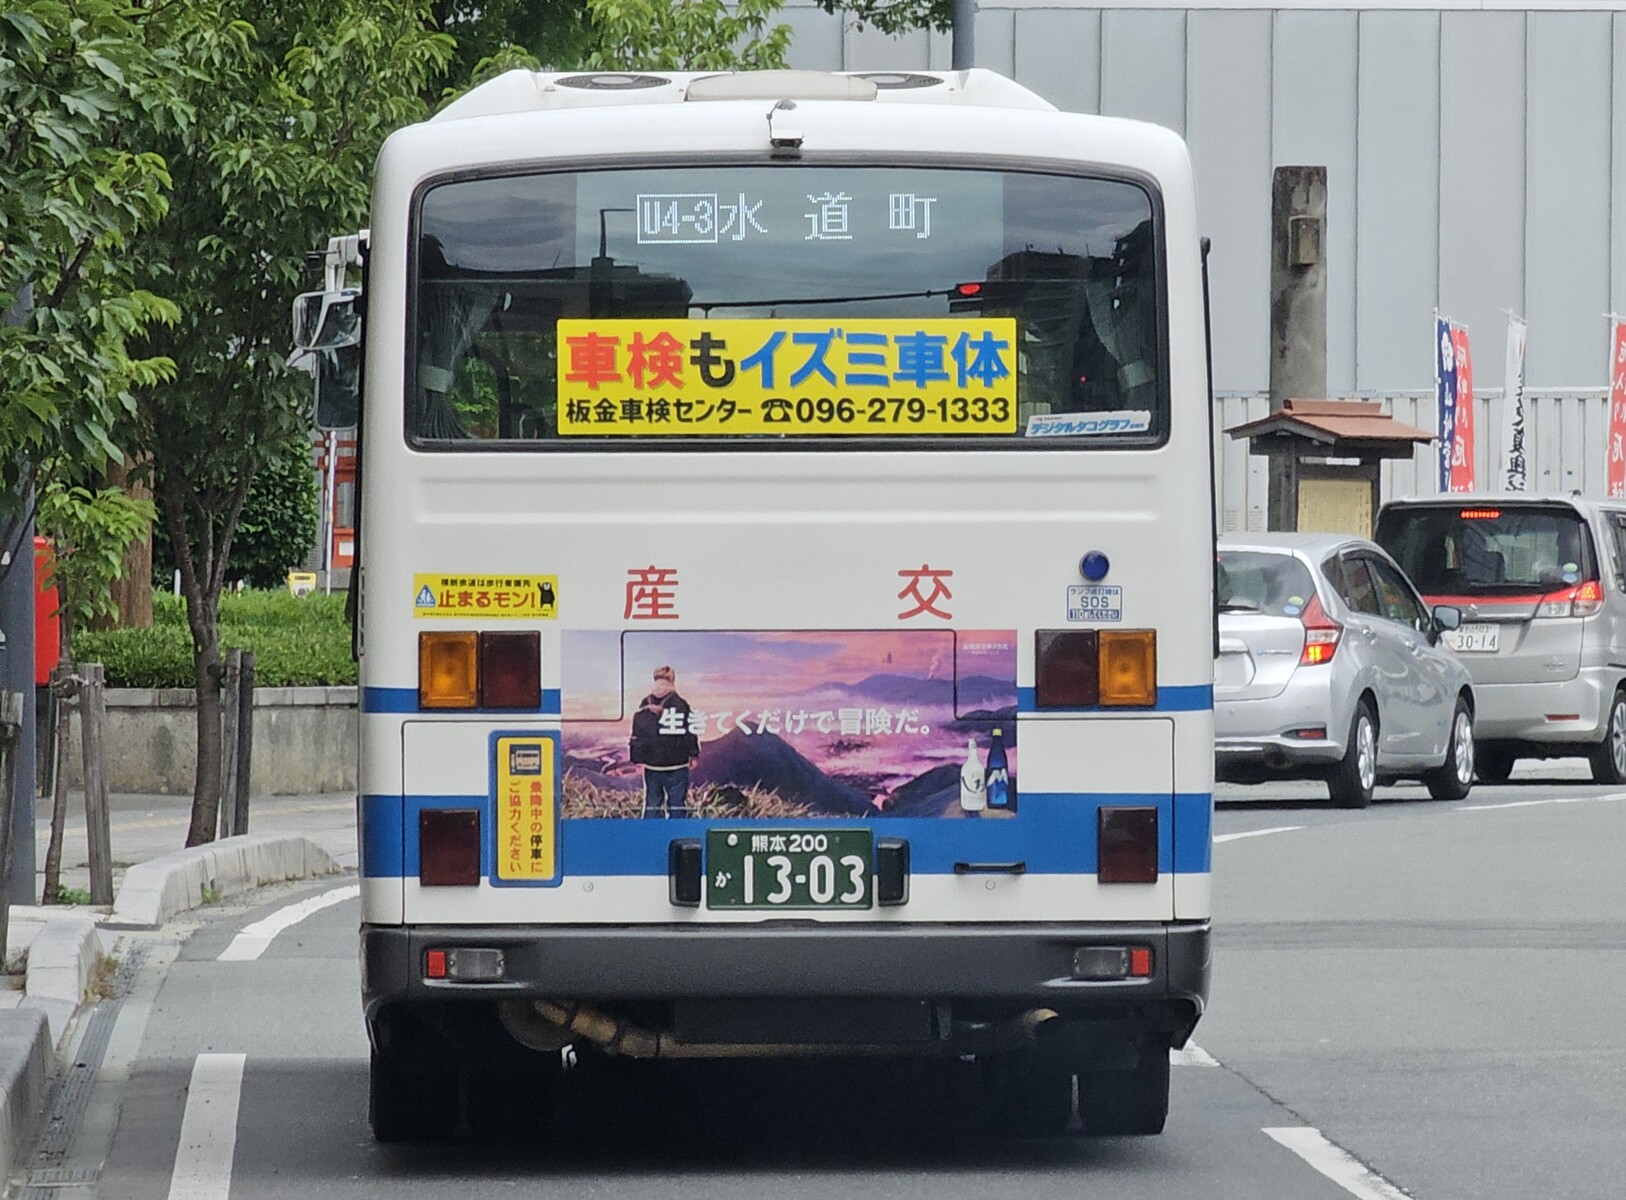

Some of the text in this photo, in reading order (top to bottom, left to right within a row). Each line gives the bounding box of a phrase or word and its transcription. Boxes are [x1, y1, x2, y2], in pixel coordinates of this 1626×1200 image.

[565, 327, 1011, 390] 車検もイズミ車体
[565, 397, 1010, 424] 板金車検センター 096-279-1333
[623, 563, 953, 620] 産 交
[1080, 596, 1109, 608] SOS
[1457, 634, 1496, 649] 30-14
[658, 707, 932, 736] 生きてくだけで冒険だ。
[509, 780, 522, 873] ご協力ください
[530, 780, 543, 874] 乗降中の停車に
[752, 834, 828, 853] 熊本200
[714, 871, 732, 888] か
[743, 855, 865, 904] 13-03
